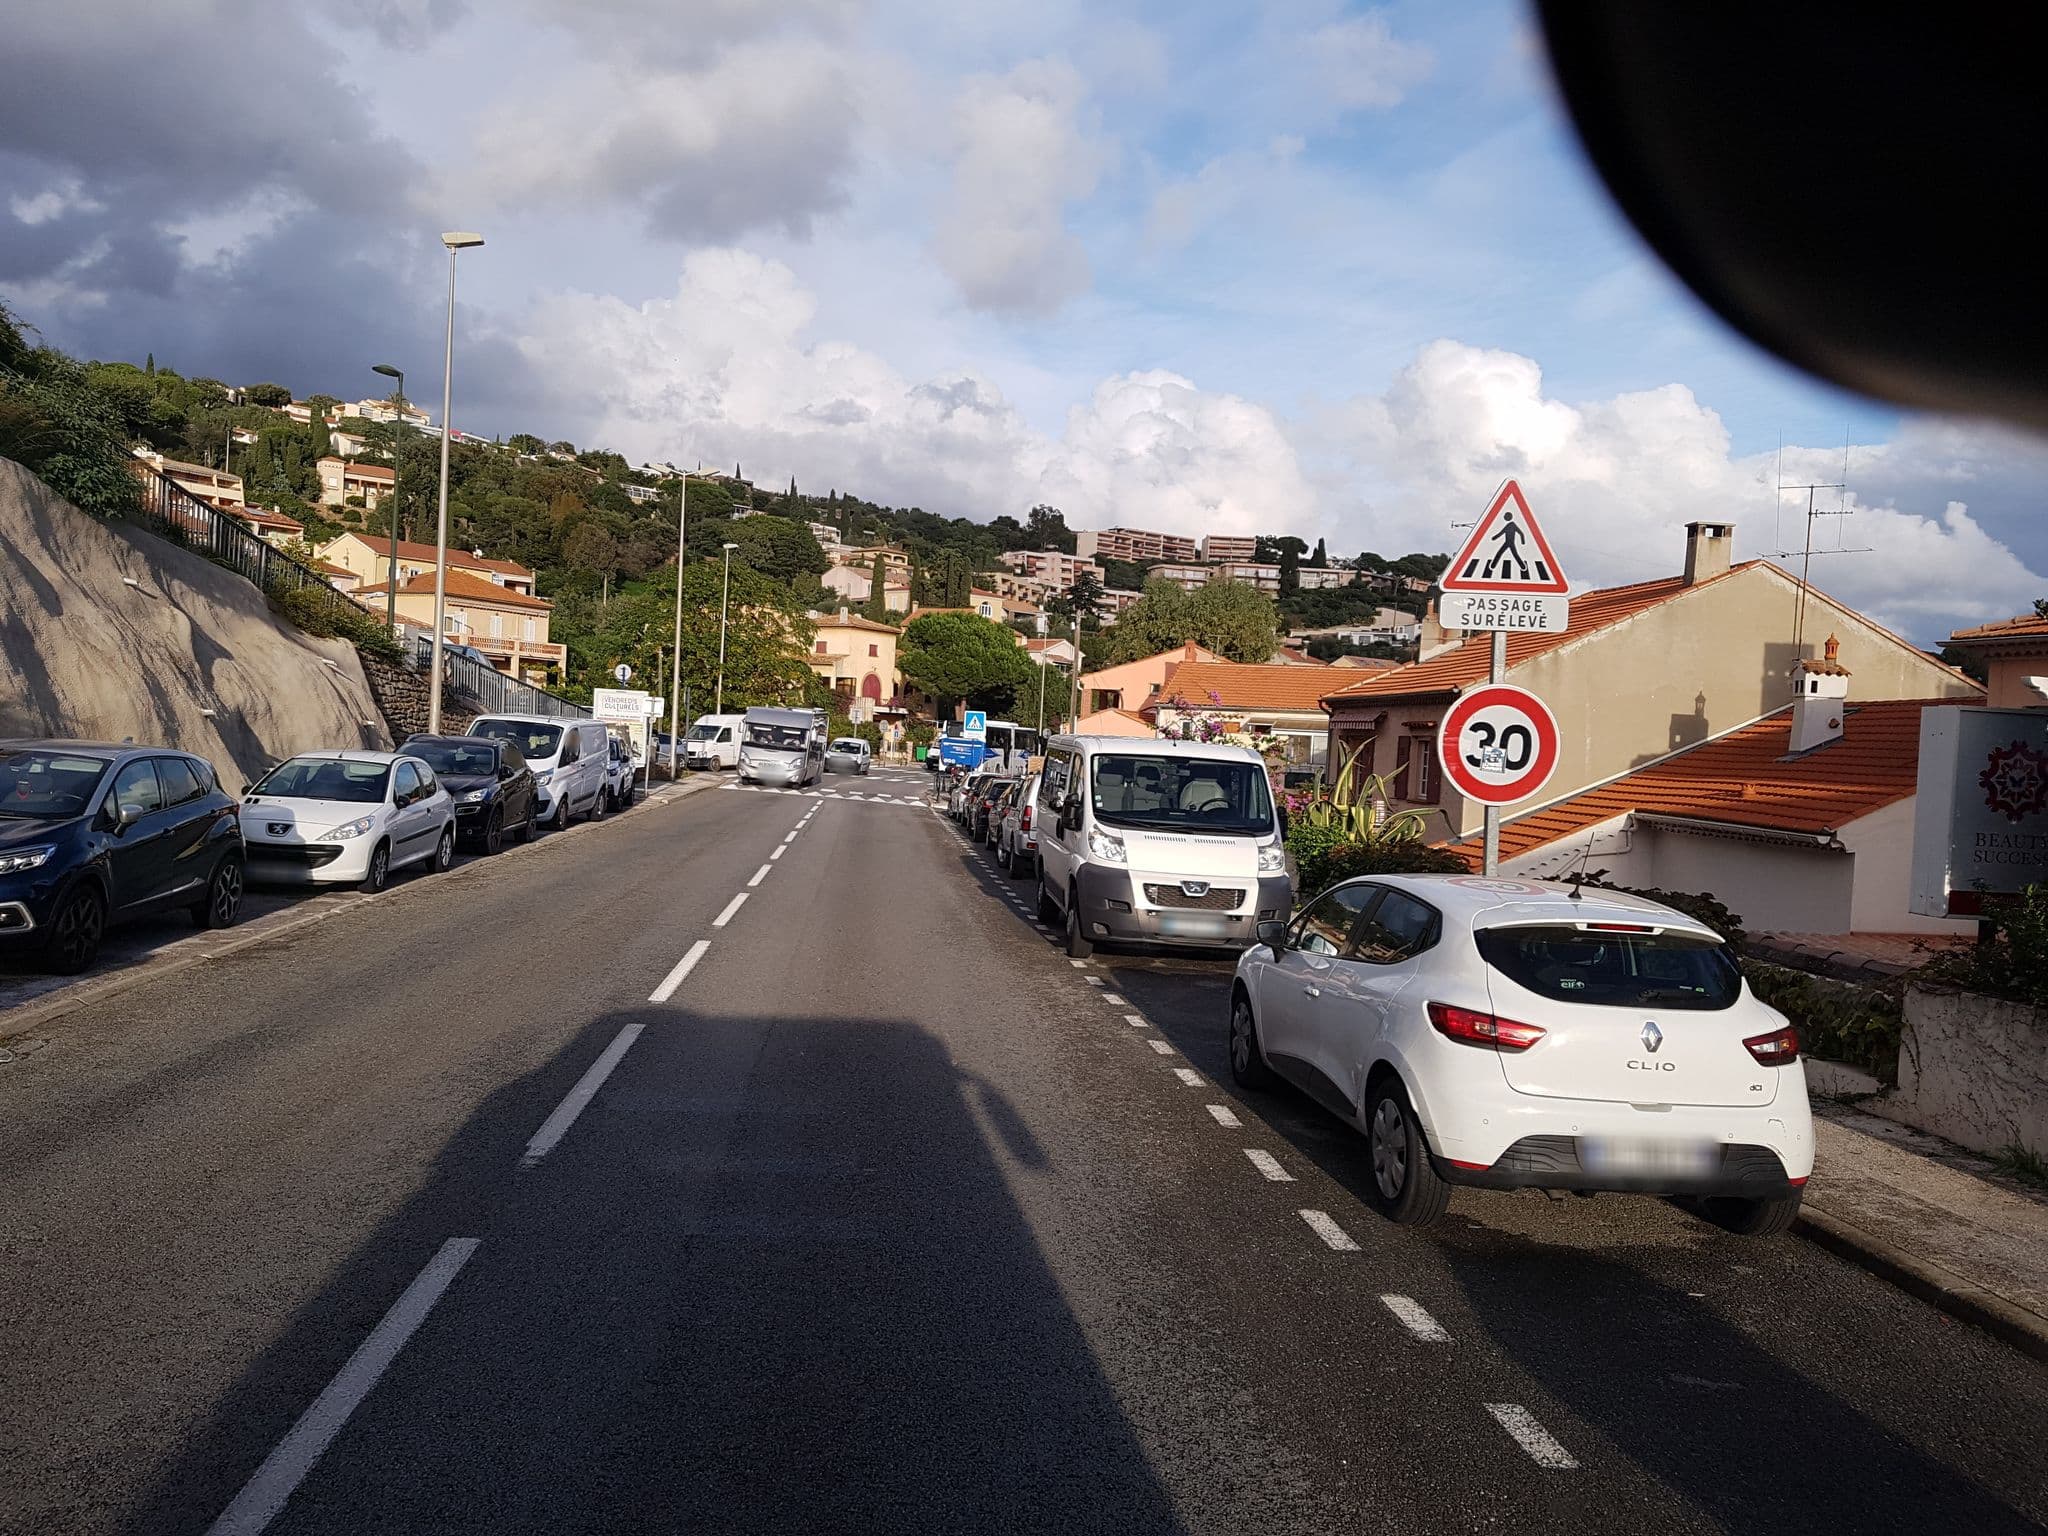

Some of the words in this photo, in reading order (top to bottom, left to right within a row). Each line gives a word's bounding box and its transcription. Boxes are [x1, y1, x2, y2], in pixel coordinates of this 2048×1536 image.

[1467, 598, 1543, 612] PASSAGE
[1461, 612, 1548, 628] SURÉLEVÉ
[1465, 721, 1532, 771] 30
[1626, 1060, 1676, 1071] CLIO
